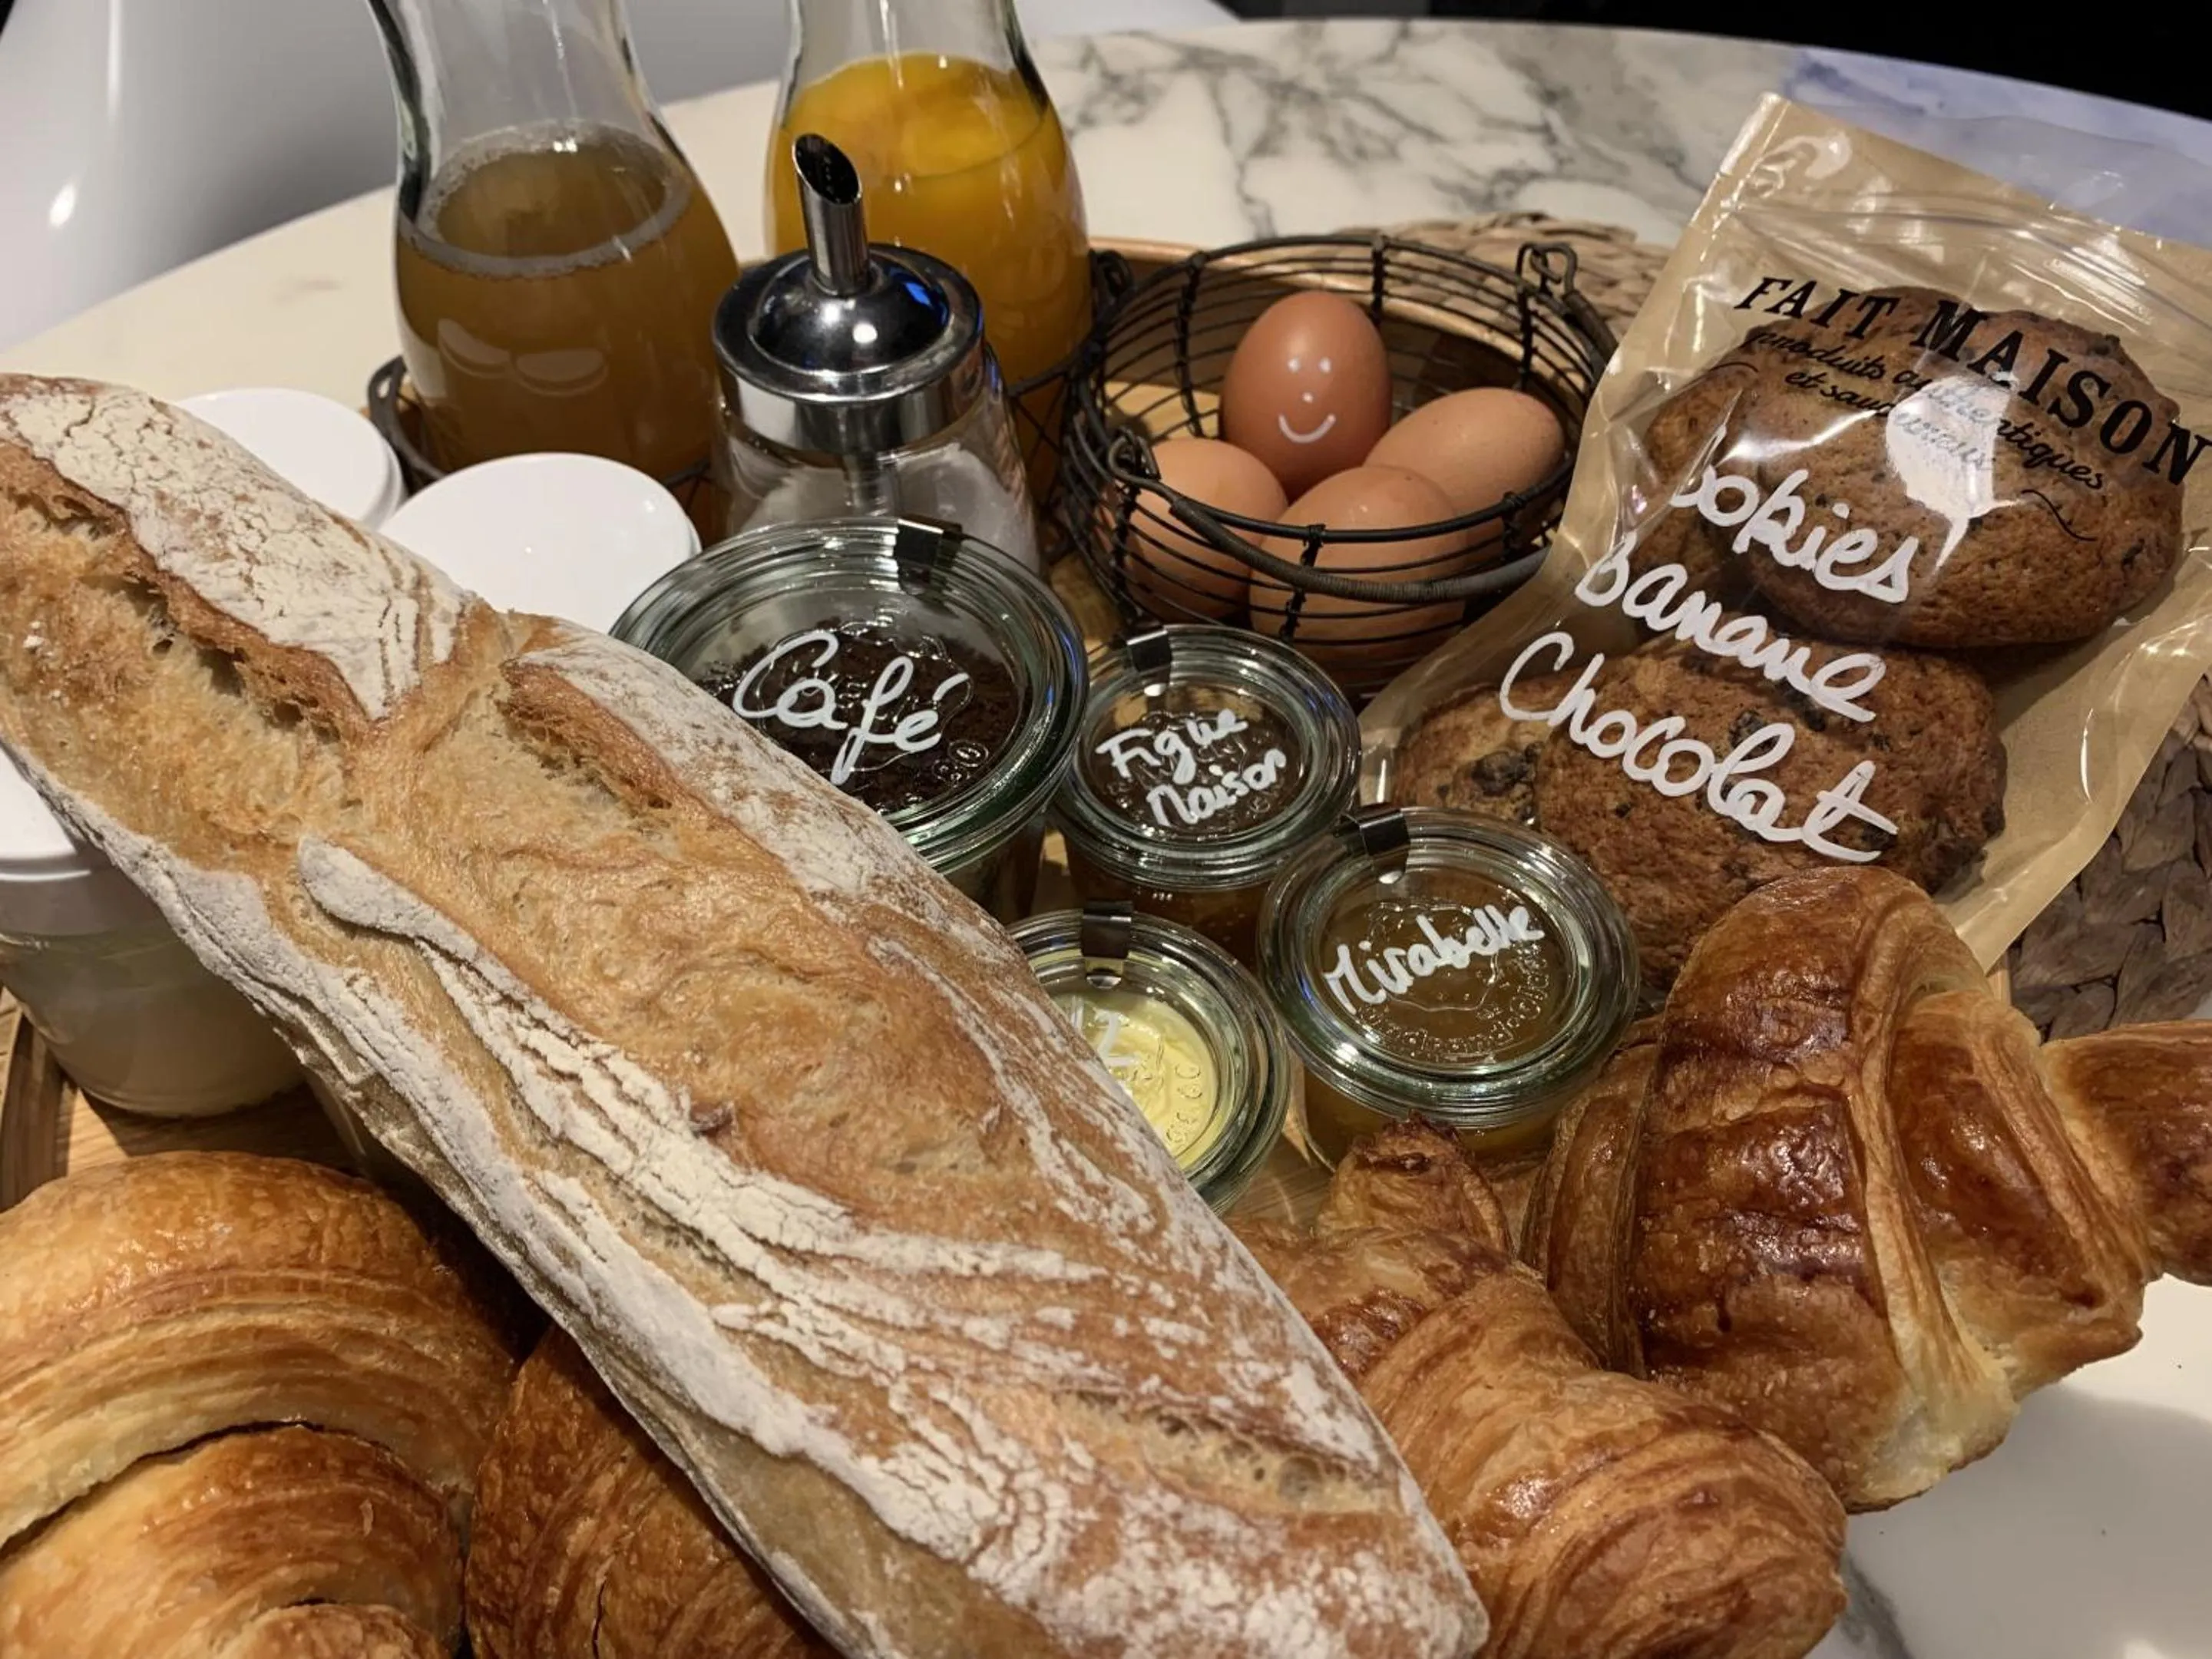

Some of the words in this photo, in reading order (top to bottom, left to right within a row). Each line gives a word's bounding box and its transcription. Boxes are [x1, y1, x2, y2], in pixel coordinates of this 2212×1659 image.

[1734, 277, 1900, 339] FAIT
[1911, 299, 2212, 485] MAISON
[1740, 332, 1886, 379] produits
[1785, 370, 1829, 389] et
[732, 630, 970, 786] Café
[1095, 708, 1249, 785] Figue
[1499, 631, 1899, 862] Chocolat
[1323, 904, 1546, 1016] Mirabelle
